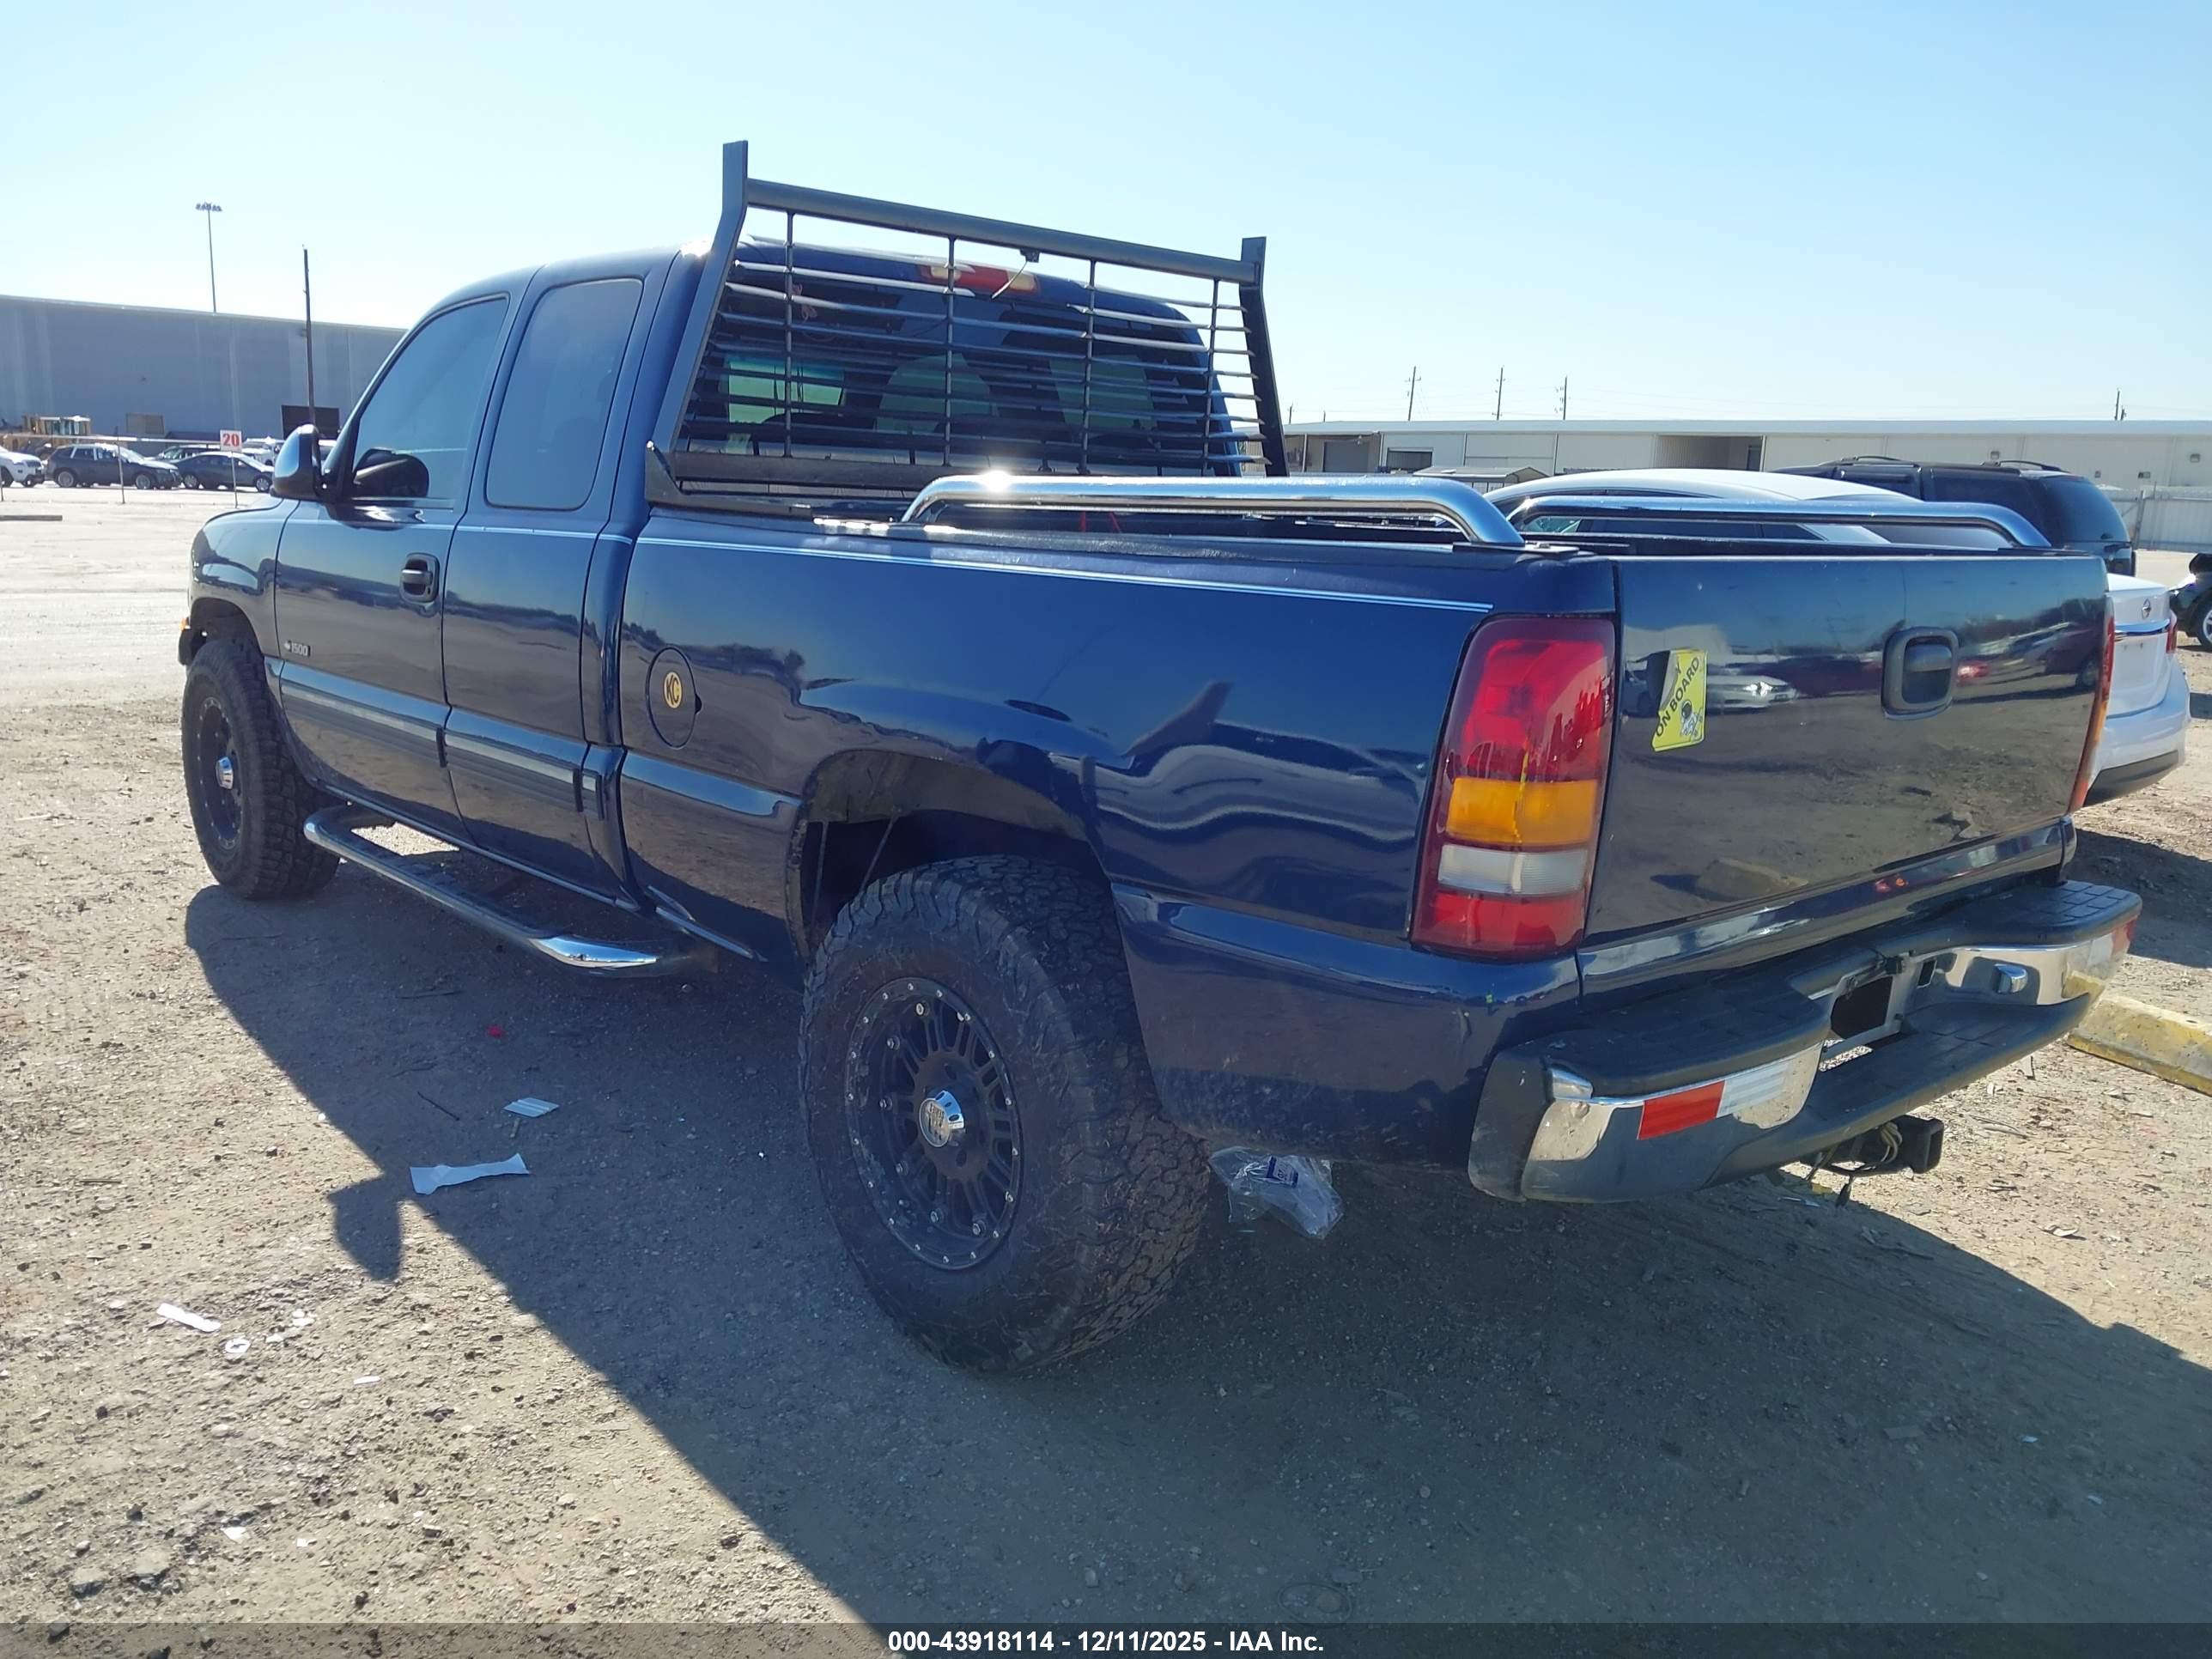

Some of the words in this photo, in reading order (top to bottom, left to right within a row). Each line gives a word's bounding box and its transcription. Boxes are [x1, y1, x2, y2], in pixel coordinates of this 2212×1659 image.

[223, 433, 240, 447] 20
[291, 642, 308, 657] 1500
[665, 674, 680, 705] KC
[1656, 710, 1671, 737] ON
[1669, 657, 1699, 712] BOARD
